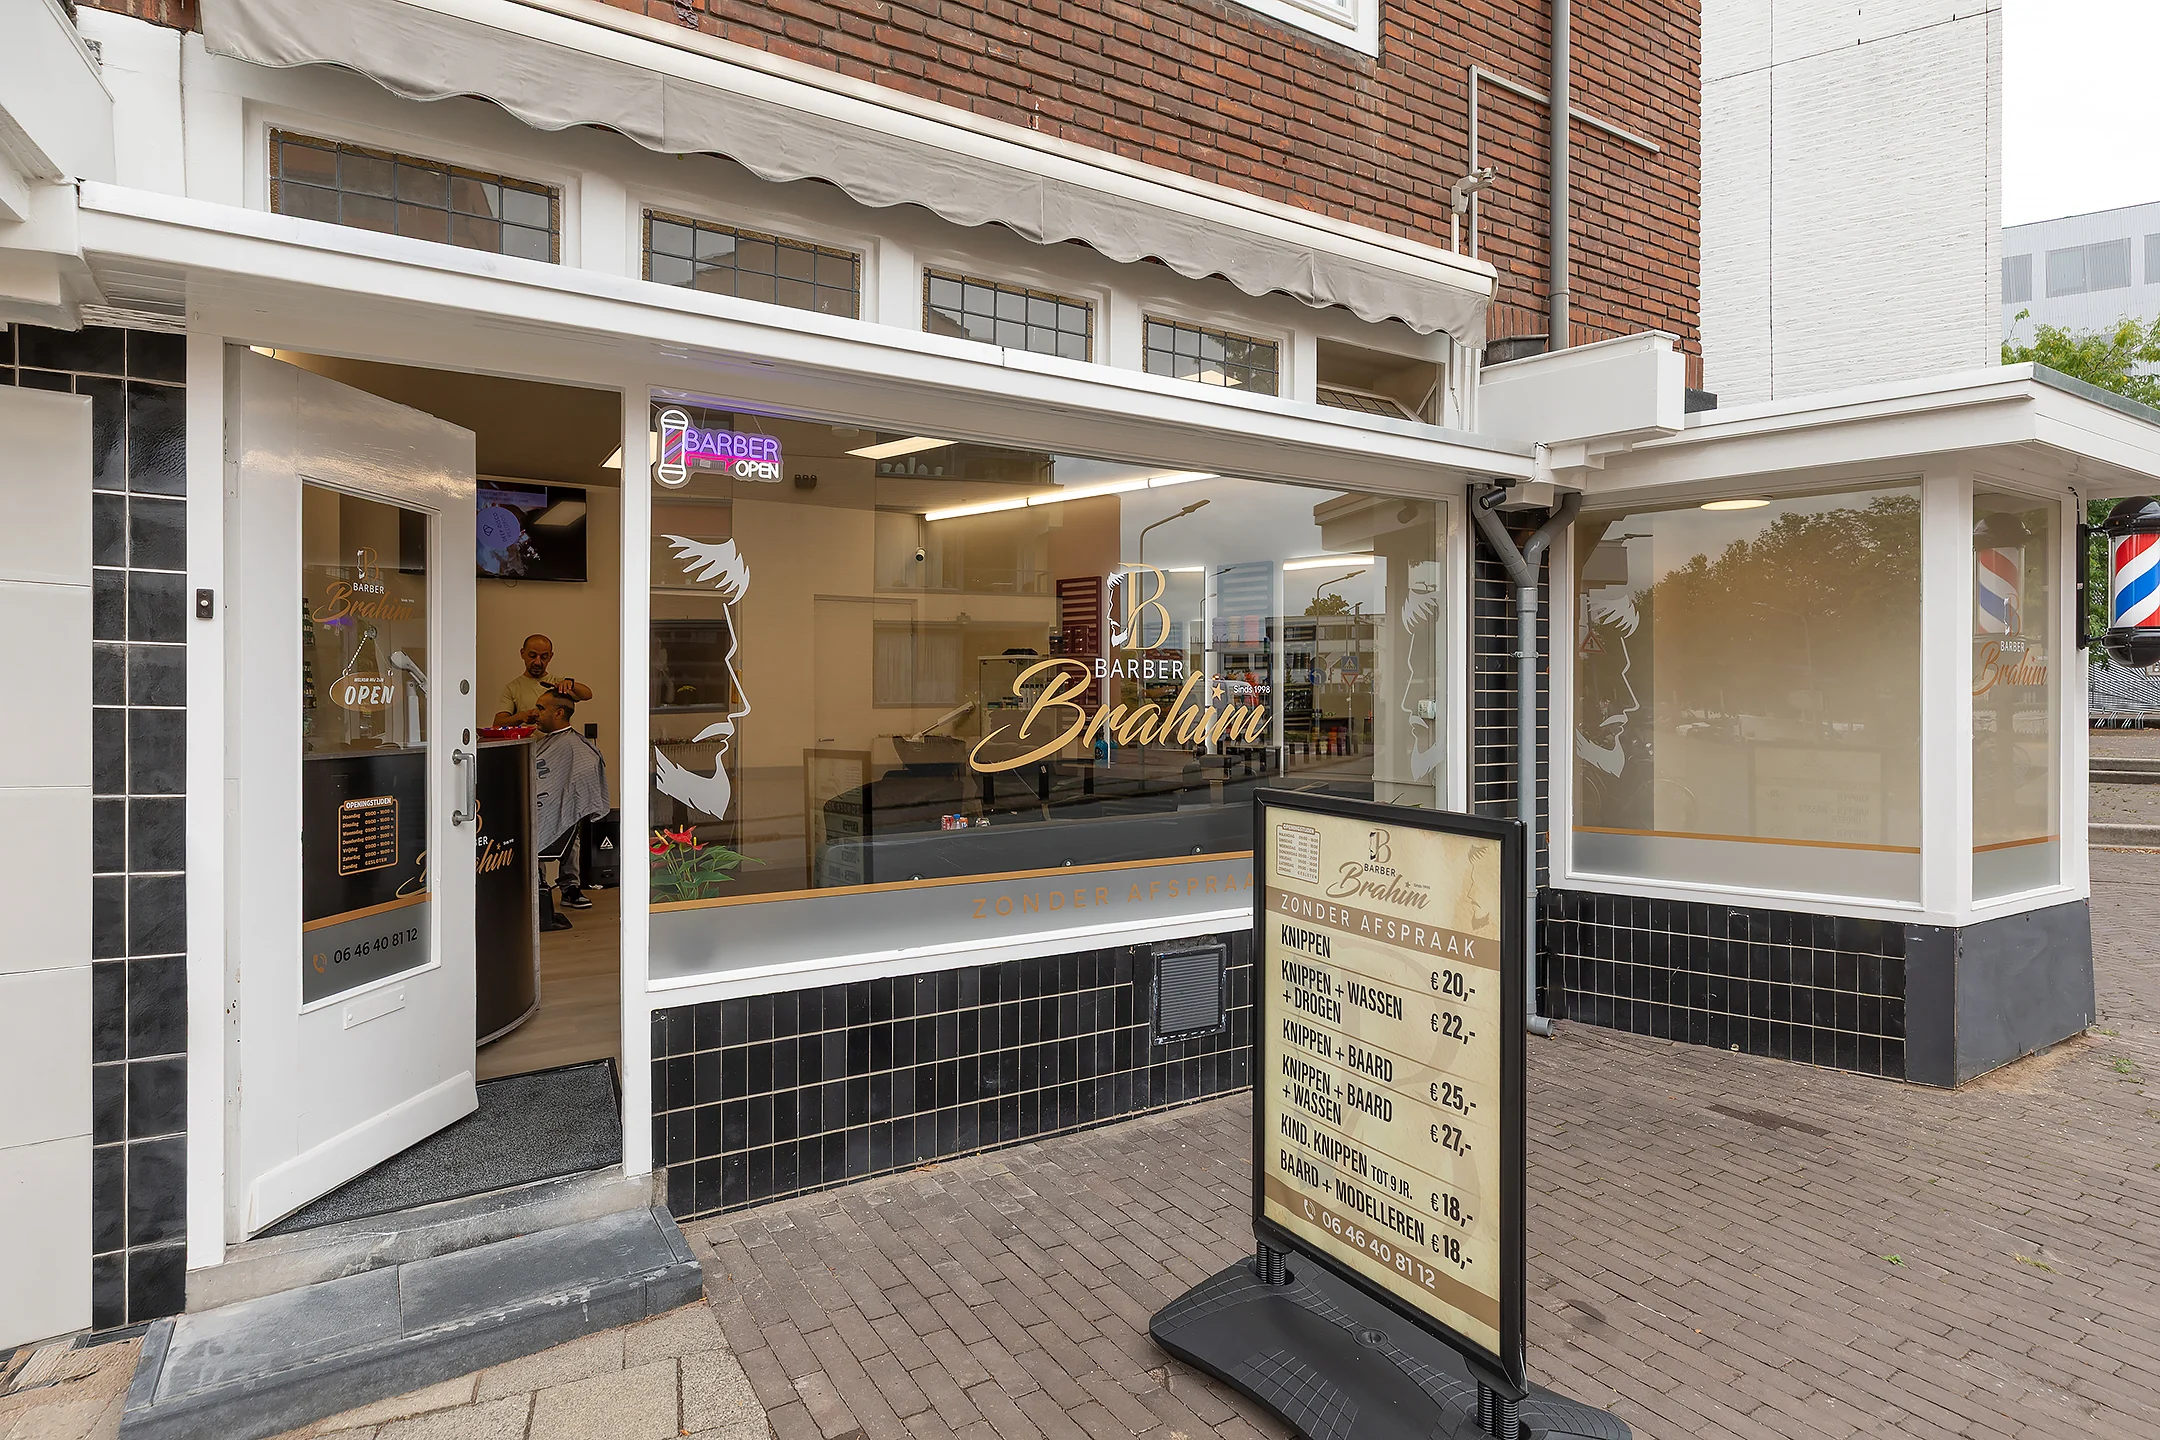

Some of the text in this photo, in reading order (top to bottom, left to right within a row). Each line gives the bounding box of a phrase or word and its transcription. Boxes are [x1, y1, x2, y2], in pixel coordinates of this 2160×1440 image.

[685, 429, 779, 462] BARBER
[735, 460, 779, 480] OPEN
[312, 581, 413, 623] Brahim
[353, 582, 385, 594] BARBER
[1095, 658, 1184, 680] BARBER
[1972, 641, 2049, 697] Brahim
[2000, 640, 2025, 653] BARBER
[344, 685, 395, 705] OPEN
[1233, 684, 1271, 694] Sinds 1998
[969, 658, 1273, 774] Brahim
[1326, 861, 1431, 909] Brahim
[1364, 863, 1396, 877] BARBER
[972, 872, 1253, 919] ZONDER AFSPRAA
[333, 928, 418, 964] 06 46 40 81 12
[1281, 893, 1475, 959] ZONDER AFSPRAAK
[1281, 923, 1476, 1002] KNIPPEN € 20,-
[1281, 959, 1476, 1045] KNIPPEN + WASSEN € 22,-
[1283, 987, 1341, 1024] + DROGEN
[1283, 1018, 1476, 1116] KNIPPEN + BAARD € 25,-
[1282, 1083, 1341, 1126] + WASSEN
[1282, 1053, 1472, 1157] KNIPPEN + BAARD € 27,-
[1281, 1113, 1473, 1228] KIND. KNIPPEN TOT 9 JR. € 18,-
[1280, 1148, 1473, 1270] BAARD + MODELLEREN € 18,-
[1322, 1211, 1436, 1290] 06 46 40 81 12
